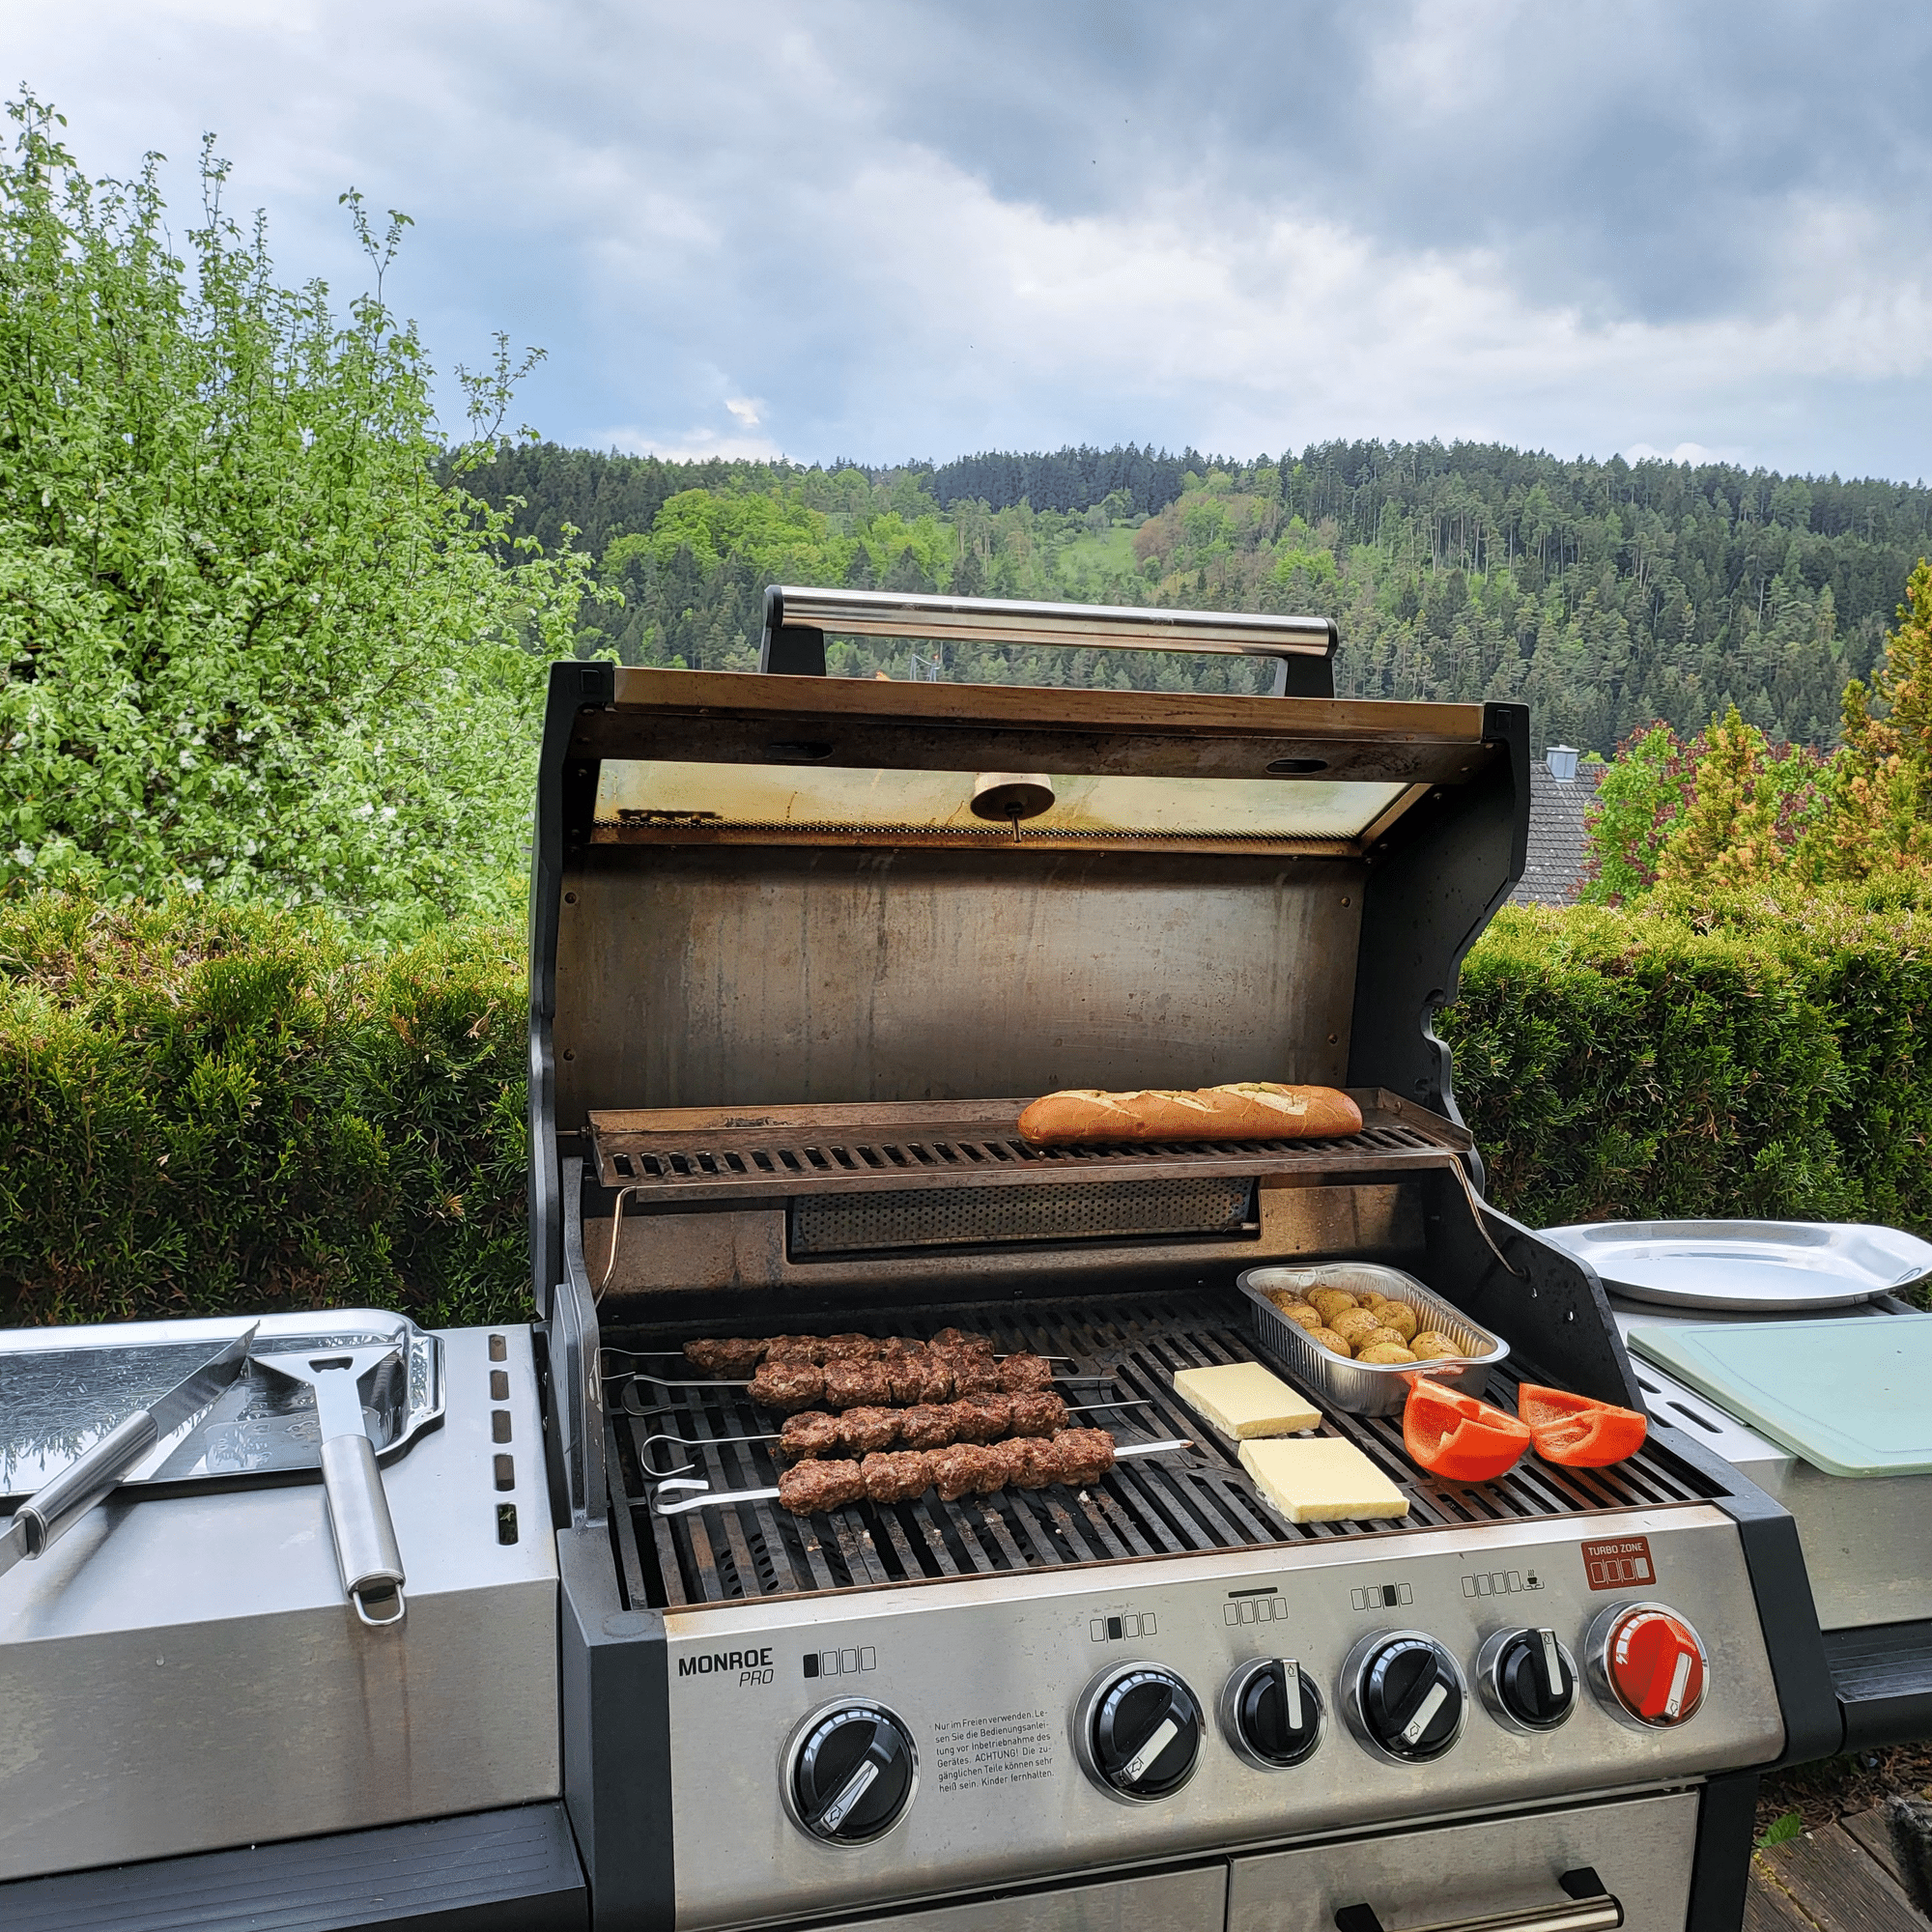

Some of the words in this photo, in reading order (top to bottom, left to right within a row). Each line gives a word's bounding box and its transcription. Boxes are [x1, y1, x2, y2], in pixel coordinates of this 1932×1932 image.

[1588, 1545, 1618, 1556] TURBO
[1620, 1542, 1644, 1553] ZONE
[678, 1647, 773, 1677] MONROE
[739, 1668, 774, 1688] PRO
[934, 1722, 950, 1731] Nur
[951, 1720, 961, 1729] im
[962, 1718, 987, 1727] Freien
[987, 1711, 1034, 1724] verwenden.
[1034, 1709, 1048, 1718] Le-
[935, 1735, 951, 1744] sen
[952, 1732, 964, 1741] Sie
[966, 1729, 979, 1739] die
[980, 1720, 1049, 1738] Bedienungsanlei-
[936, 1747, 955, 1756] tung
[956, 1744, 969, 1752] vor
[972, 1736, 1035, 1750] Inbetriebnahme
[1037, 1732, 1051, 1742] des
[937, 1757, 972, 1768] Gerätes.
[975, 1747, 1019, 1763] ACHTUNG!
[1022, 1747, 1036, 1756] Die
[1038, 1746, 1052, 1754] zu-
[938, 1767, 982, 1782] gänglichen
[984, 1764, 1003, 1774] Teile
[1005, 1759, 1034, 1771] können
[1035, 1757, 1053, 1766] sehr
[939, 1782, 957, 1793] heiß
[959, 1780, 980, 1790] sein.
[981, 1776, 1009, 1786] Kinder
[1010, 1770, 1055, 1782] fernhalten.
